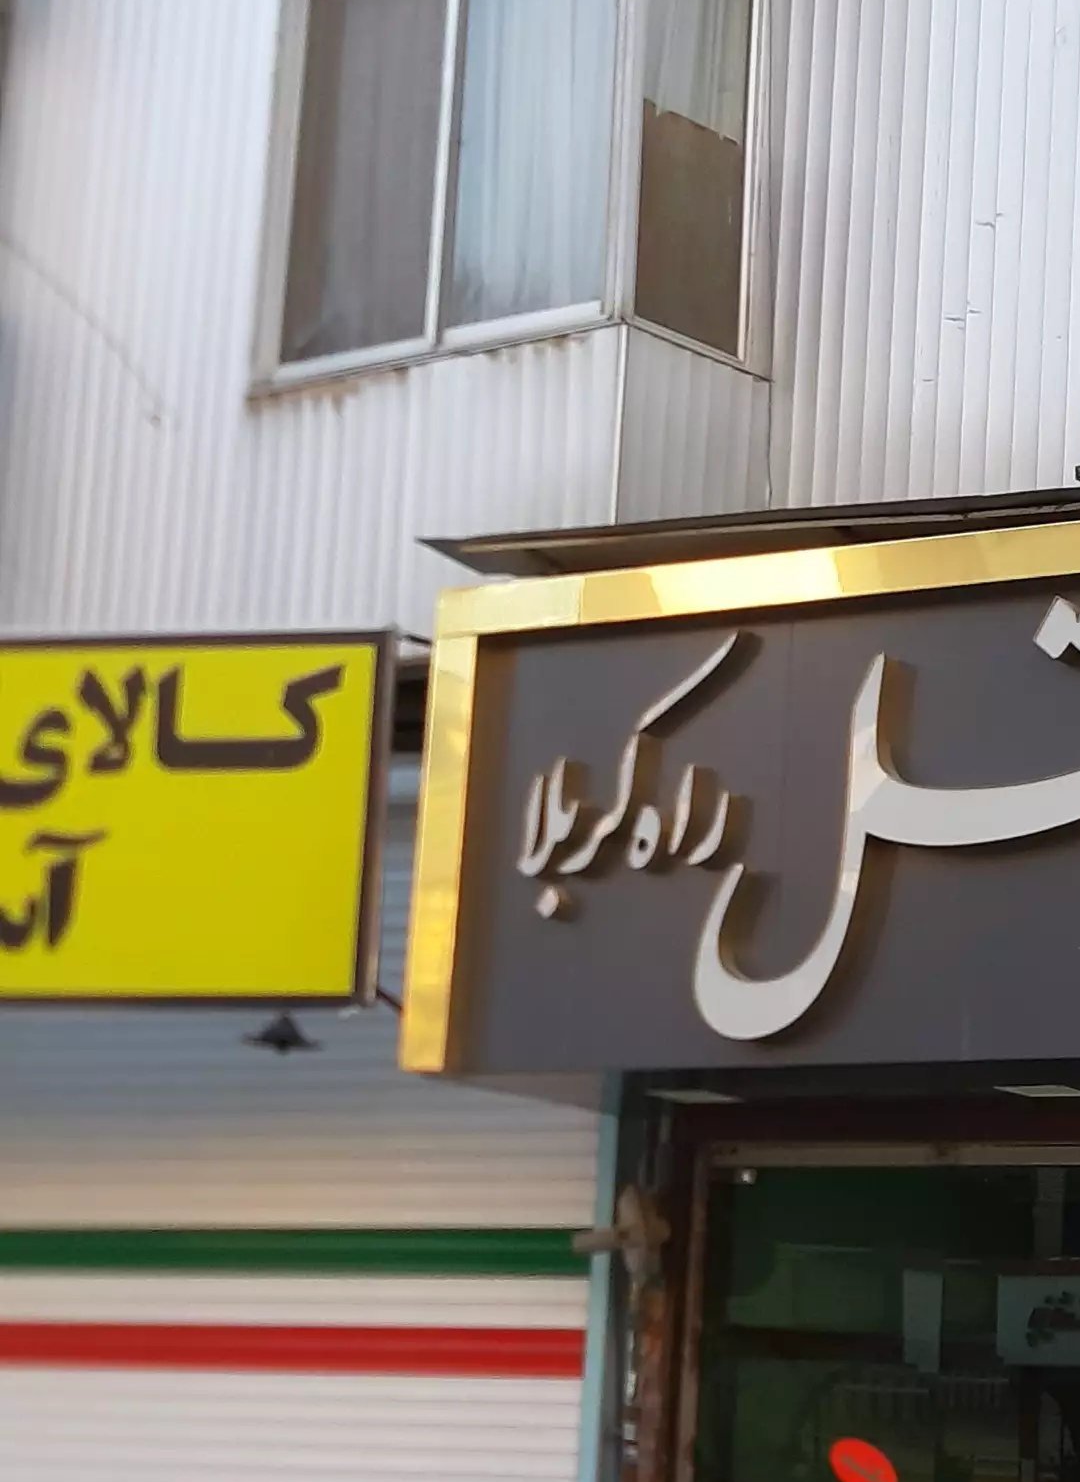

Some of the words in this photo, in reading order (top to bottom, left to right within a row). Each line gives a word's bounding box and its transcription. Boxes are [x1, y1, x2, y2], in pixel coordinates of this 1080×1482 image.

[0, 663, 346, 808] کالای
[516, 629, 742, 919] کربلا
[627, 762, 730, 870] راه
